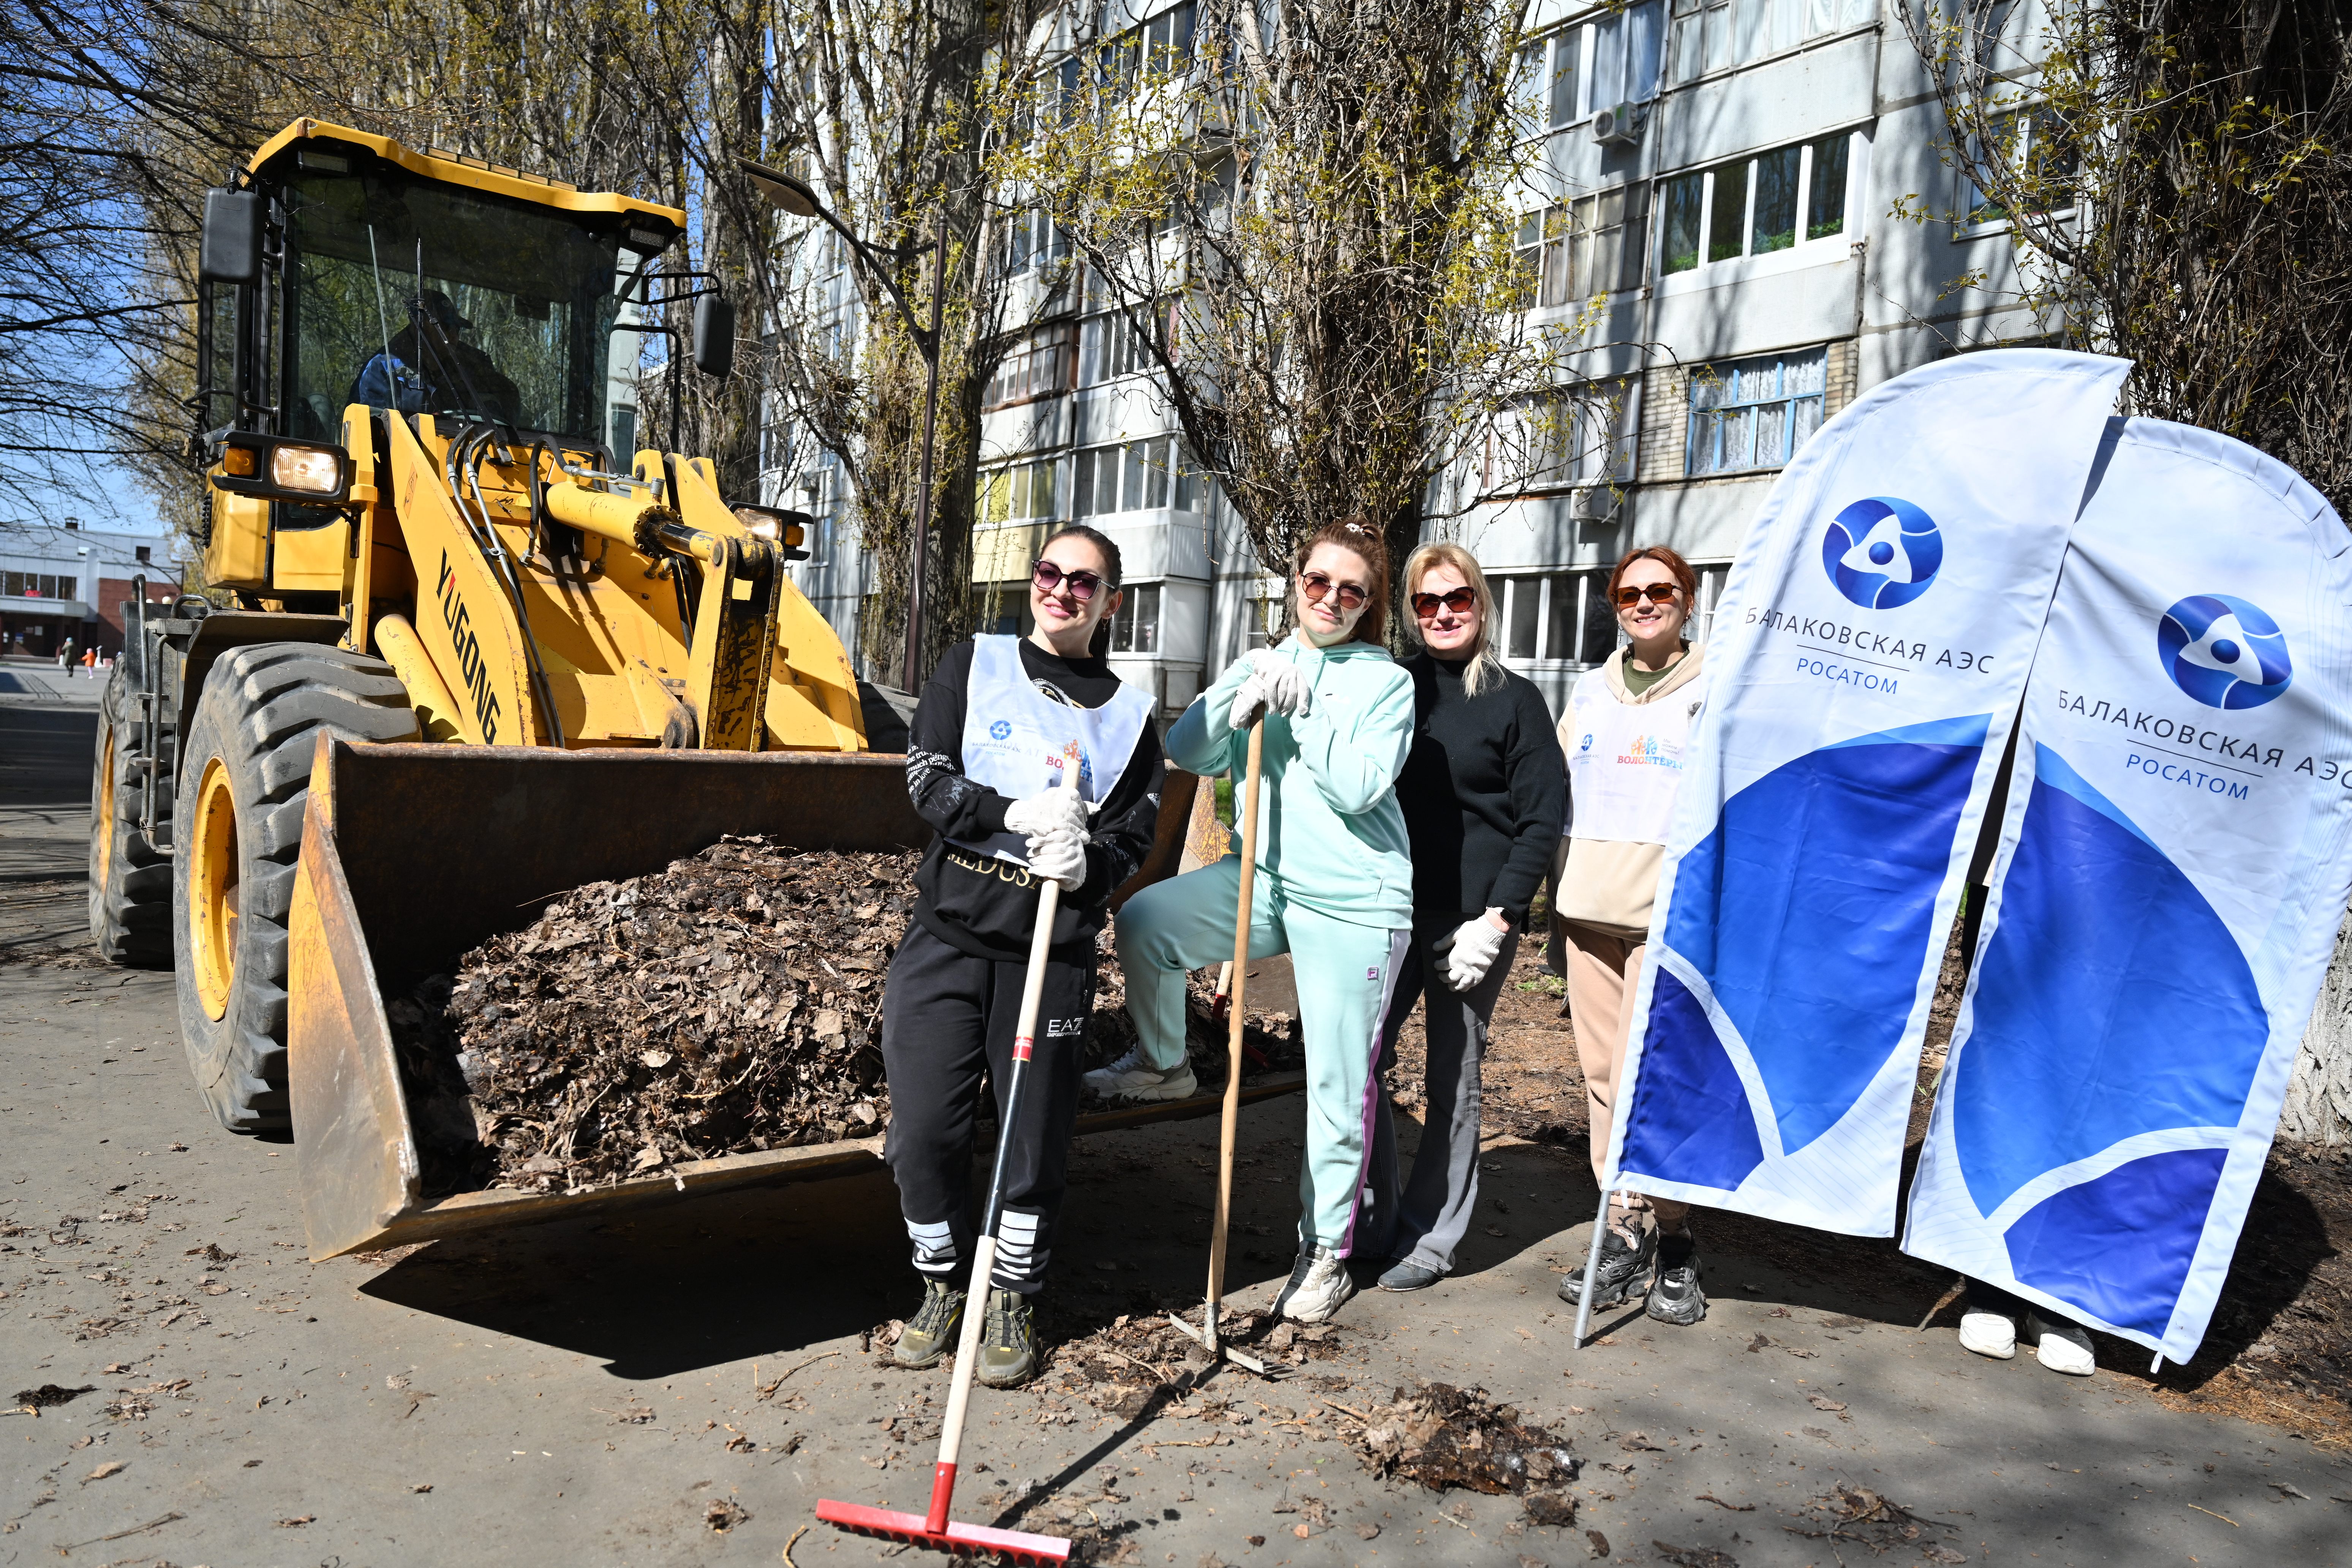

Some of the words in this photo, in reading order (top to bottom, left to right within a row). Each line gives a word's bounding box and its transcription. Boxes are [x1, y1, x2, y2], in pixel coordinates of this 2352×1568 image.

[436, 546, 500, 744] YUGONG
[1745, 607, 1927, 662] БАЛАКОВСКАЯ
[1936, 649, 1994, 674] АЭС
[1797, 658, 1898, 694] РОСАТОМ
[2059, 689, 2284, 768] БАЛАКОВСКАЯ
[913, 779, 920, 788] in
[918, 768, 931, 780] love
[1617, 756, 1683, 770] ВОЛОНТЁРЫ
[2126, 754, 2249, 800] РОСАТОМ
[1048, 1017, 1084, 1032] EA7
